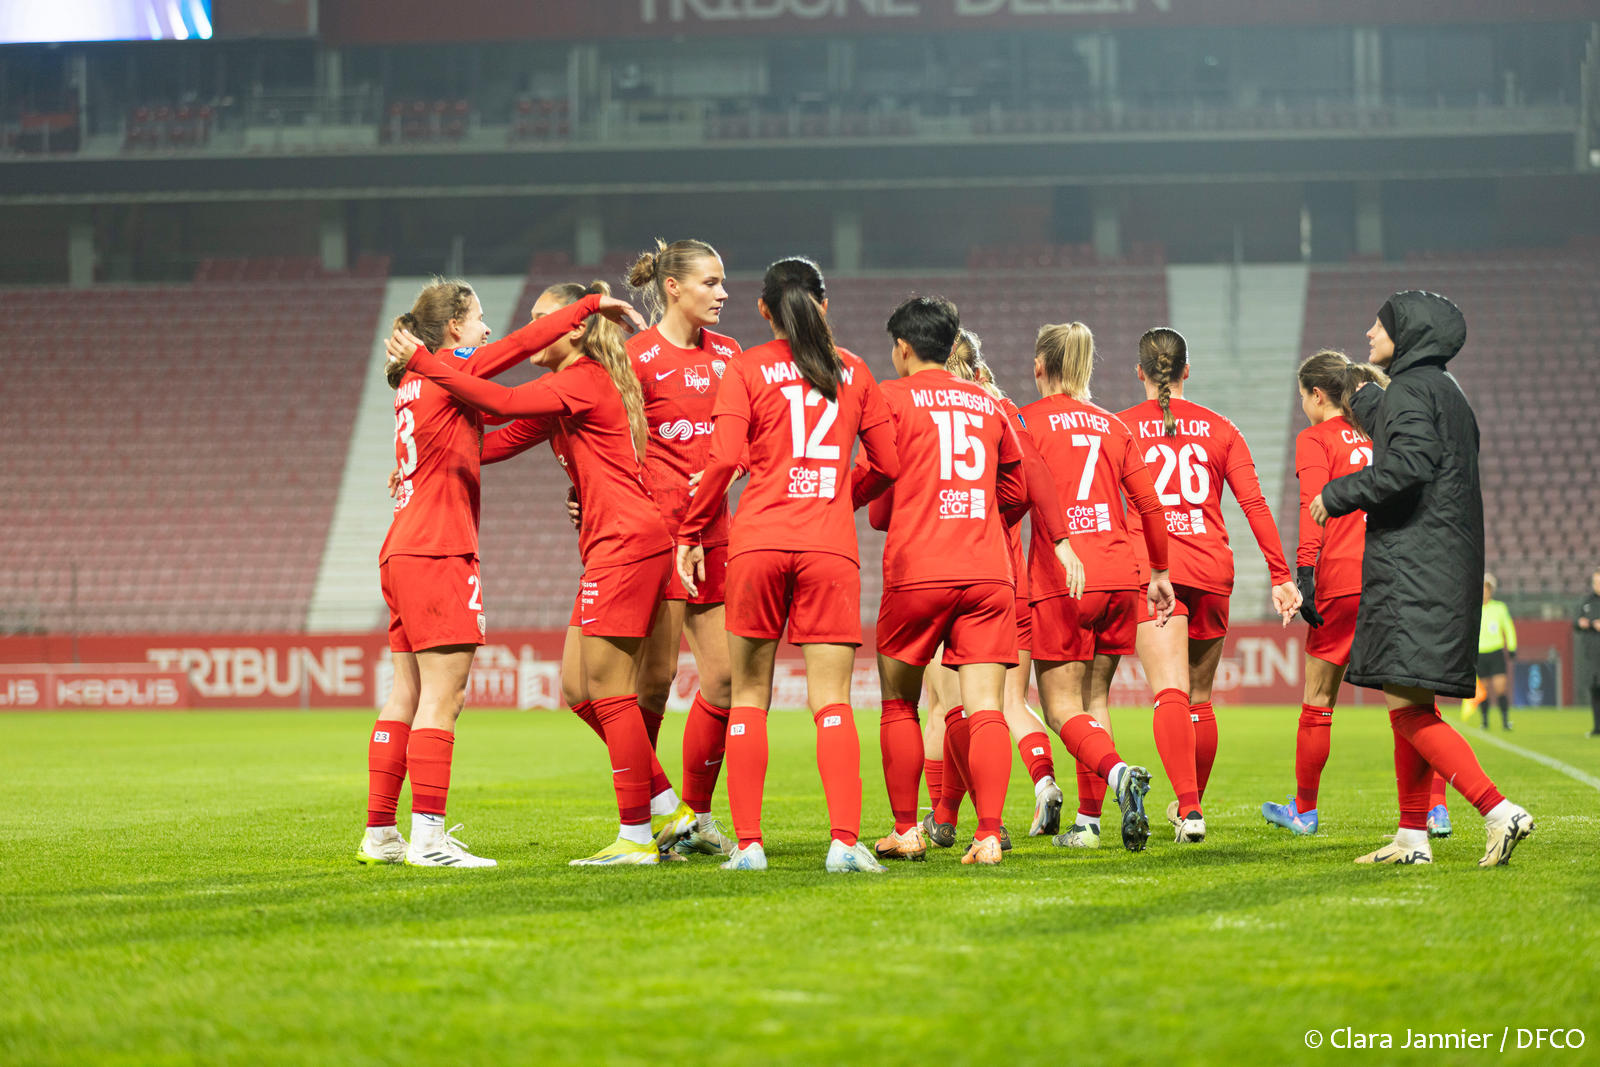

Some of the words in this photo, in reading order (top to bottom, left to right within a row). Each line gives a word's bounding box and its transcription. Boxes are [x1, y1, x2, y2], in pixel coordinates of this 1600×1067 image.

[684, 374, 710, 390] Dijon
[911, 389, 934, 407] WU
[780, 385, 840, 460] 12
[1048, 411, 1111, 434] PINTHER
[929, 410, 986, 480] 15
[789, 466, 819, 480] Côte
[1071, 434, 1102, 500] 7
[1144, 443, 1210, 506] 26
[788, 480, 818, 493] d'Or
[939, 489, 969, 501] Côte
[939, 501, 969, 514] d'Or
[1066, 505, 1094, 518] Côte
[1068, 517, 1095, 530] d'Or
[1164, 511, 1189, 522] Côte
[1167, 520, 1190, 532] d'Or
[147, 647, 365, 698] TRIBUNE
[375, 731, 389, 742] 23
